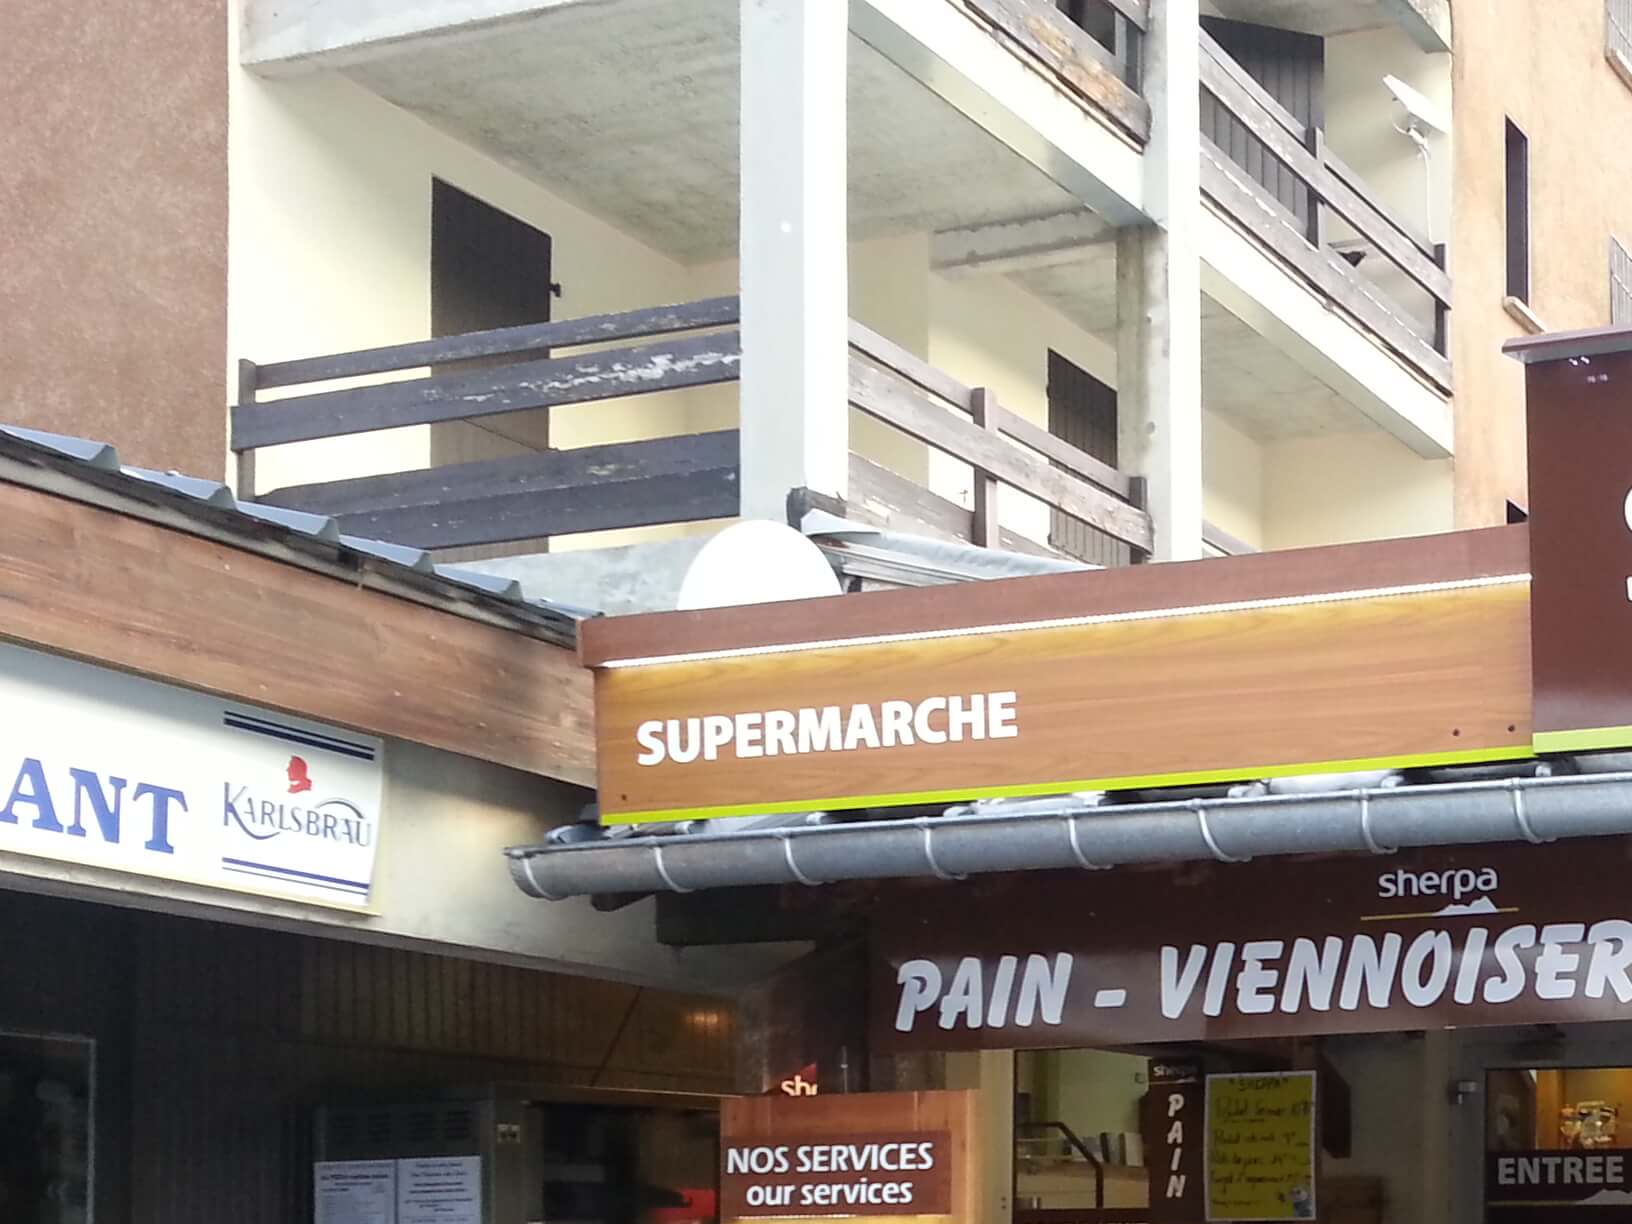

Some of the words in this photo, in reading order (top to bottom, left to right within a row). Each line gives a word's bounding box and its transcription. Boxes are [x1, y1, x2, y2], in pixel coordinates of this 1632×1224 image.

[636, 691, 1018, 766] SUPERMARCHE
[0, 757, 188, 854] ANT
[1378, 867, 1498, 900] sherpa
[895, 952, 1073, 1032] PAIN
[727, 1147, 789, 1173] NOS
[796, 1142, 934, 1172] SERVICES
[1165, 1094, 1186, 1198] PAIN
[1498, 1156, 1624, 1185] ENTREE
[746, 1184, 795, 1206] our
[801, 1178, 913, 1204] services
